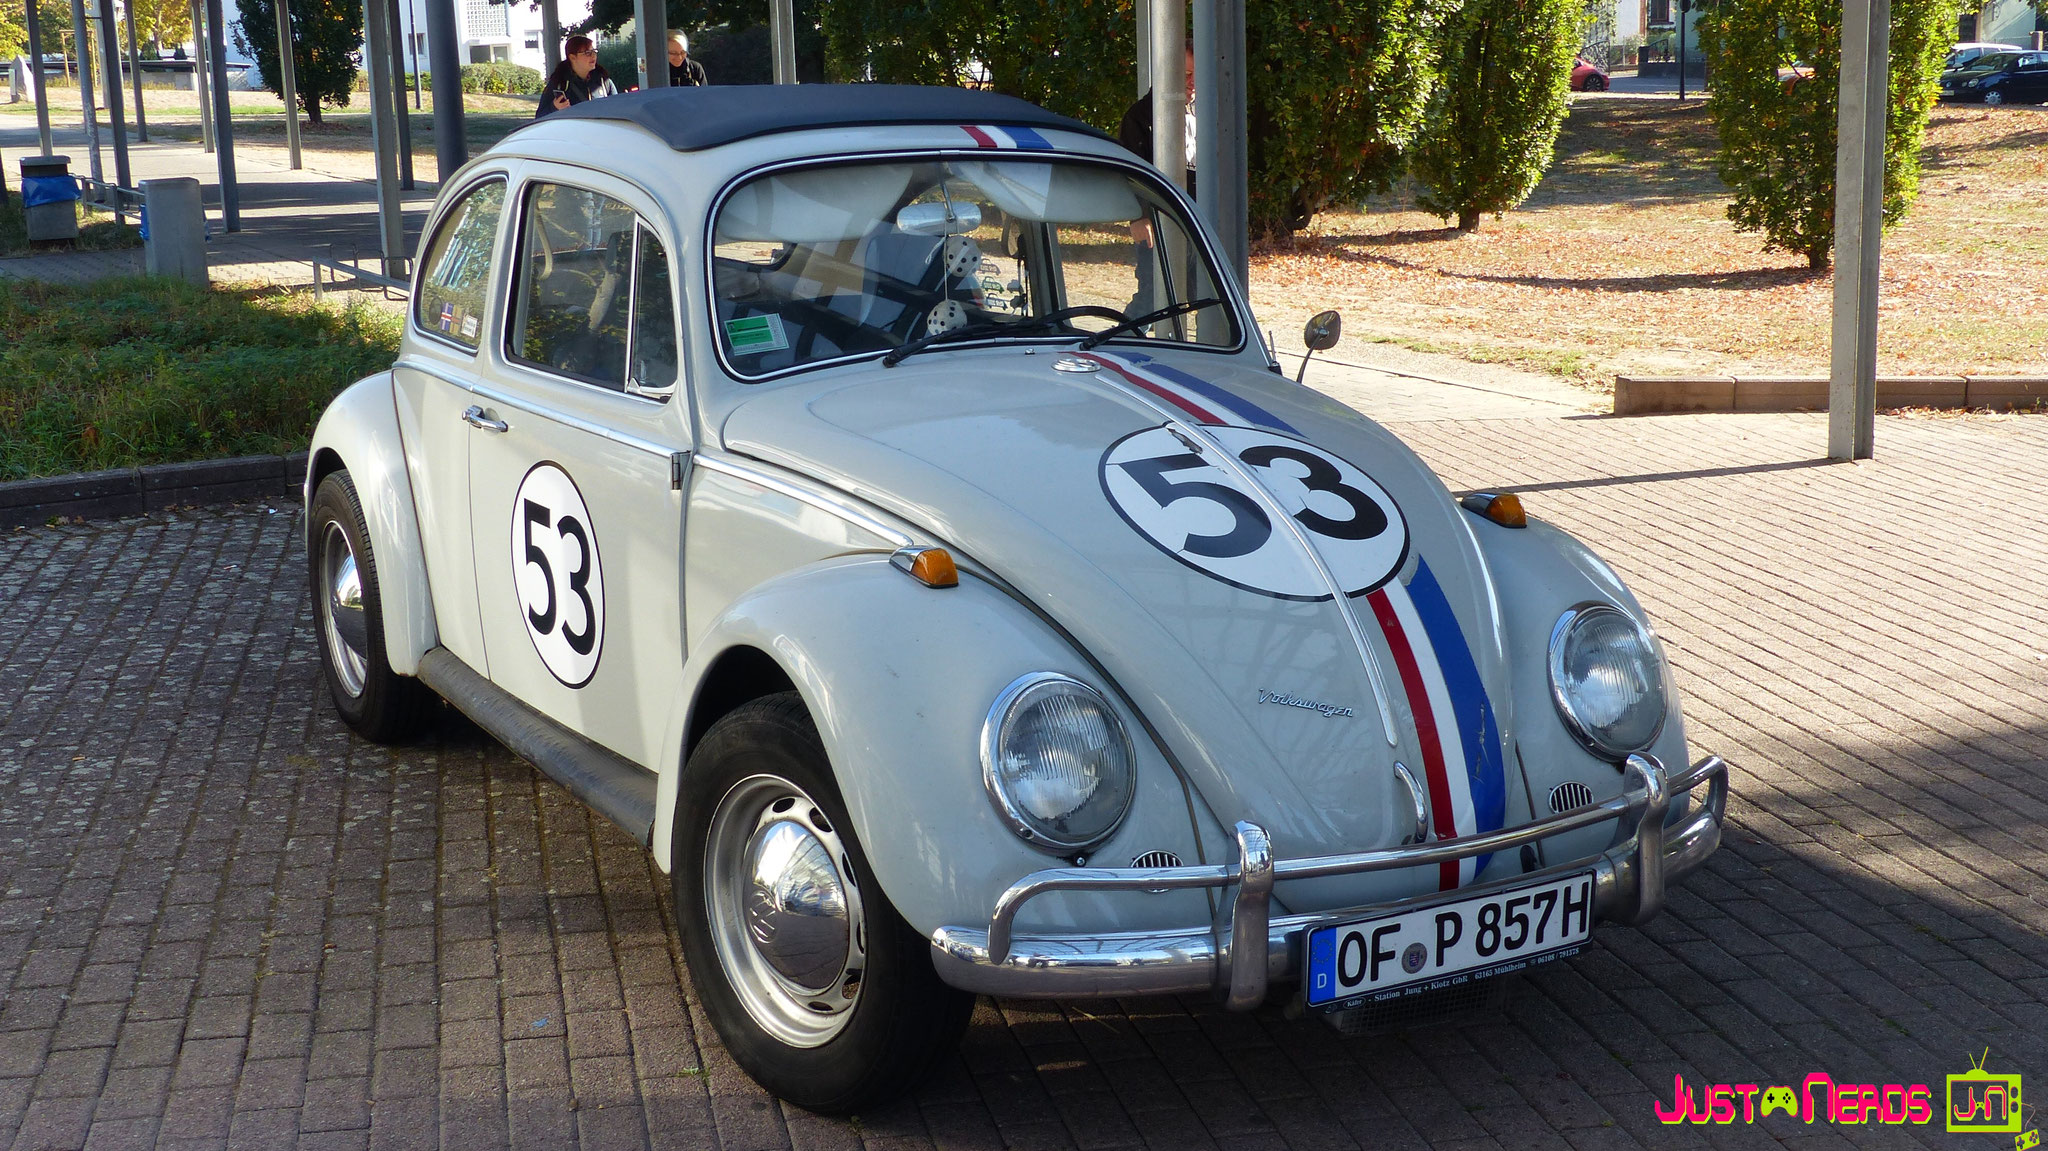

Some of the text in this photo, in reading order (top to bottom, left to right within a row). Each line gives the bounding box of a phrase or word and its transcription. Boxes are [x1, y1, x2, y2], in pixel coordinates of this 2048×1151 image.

[1118, 445, 1388, 558] 53
[524, 498, 596, 656] 53
[1259, 688, 1353, 718] Volkswagen
[1338, 880, 1590, 988] OF P 857H
[1317, 973, 1327, 989] D
[1374, 991, 1400, 1002] Station
[1404, 986, 1422, 996] Jung
[1431, 979, 1450, 990] Klotz
[1452, 976, 1468, 985] GbR
